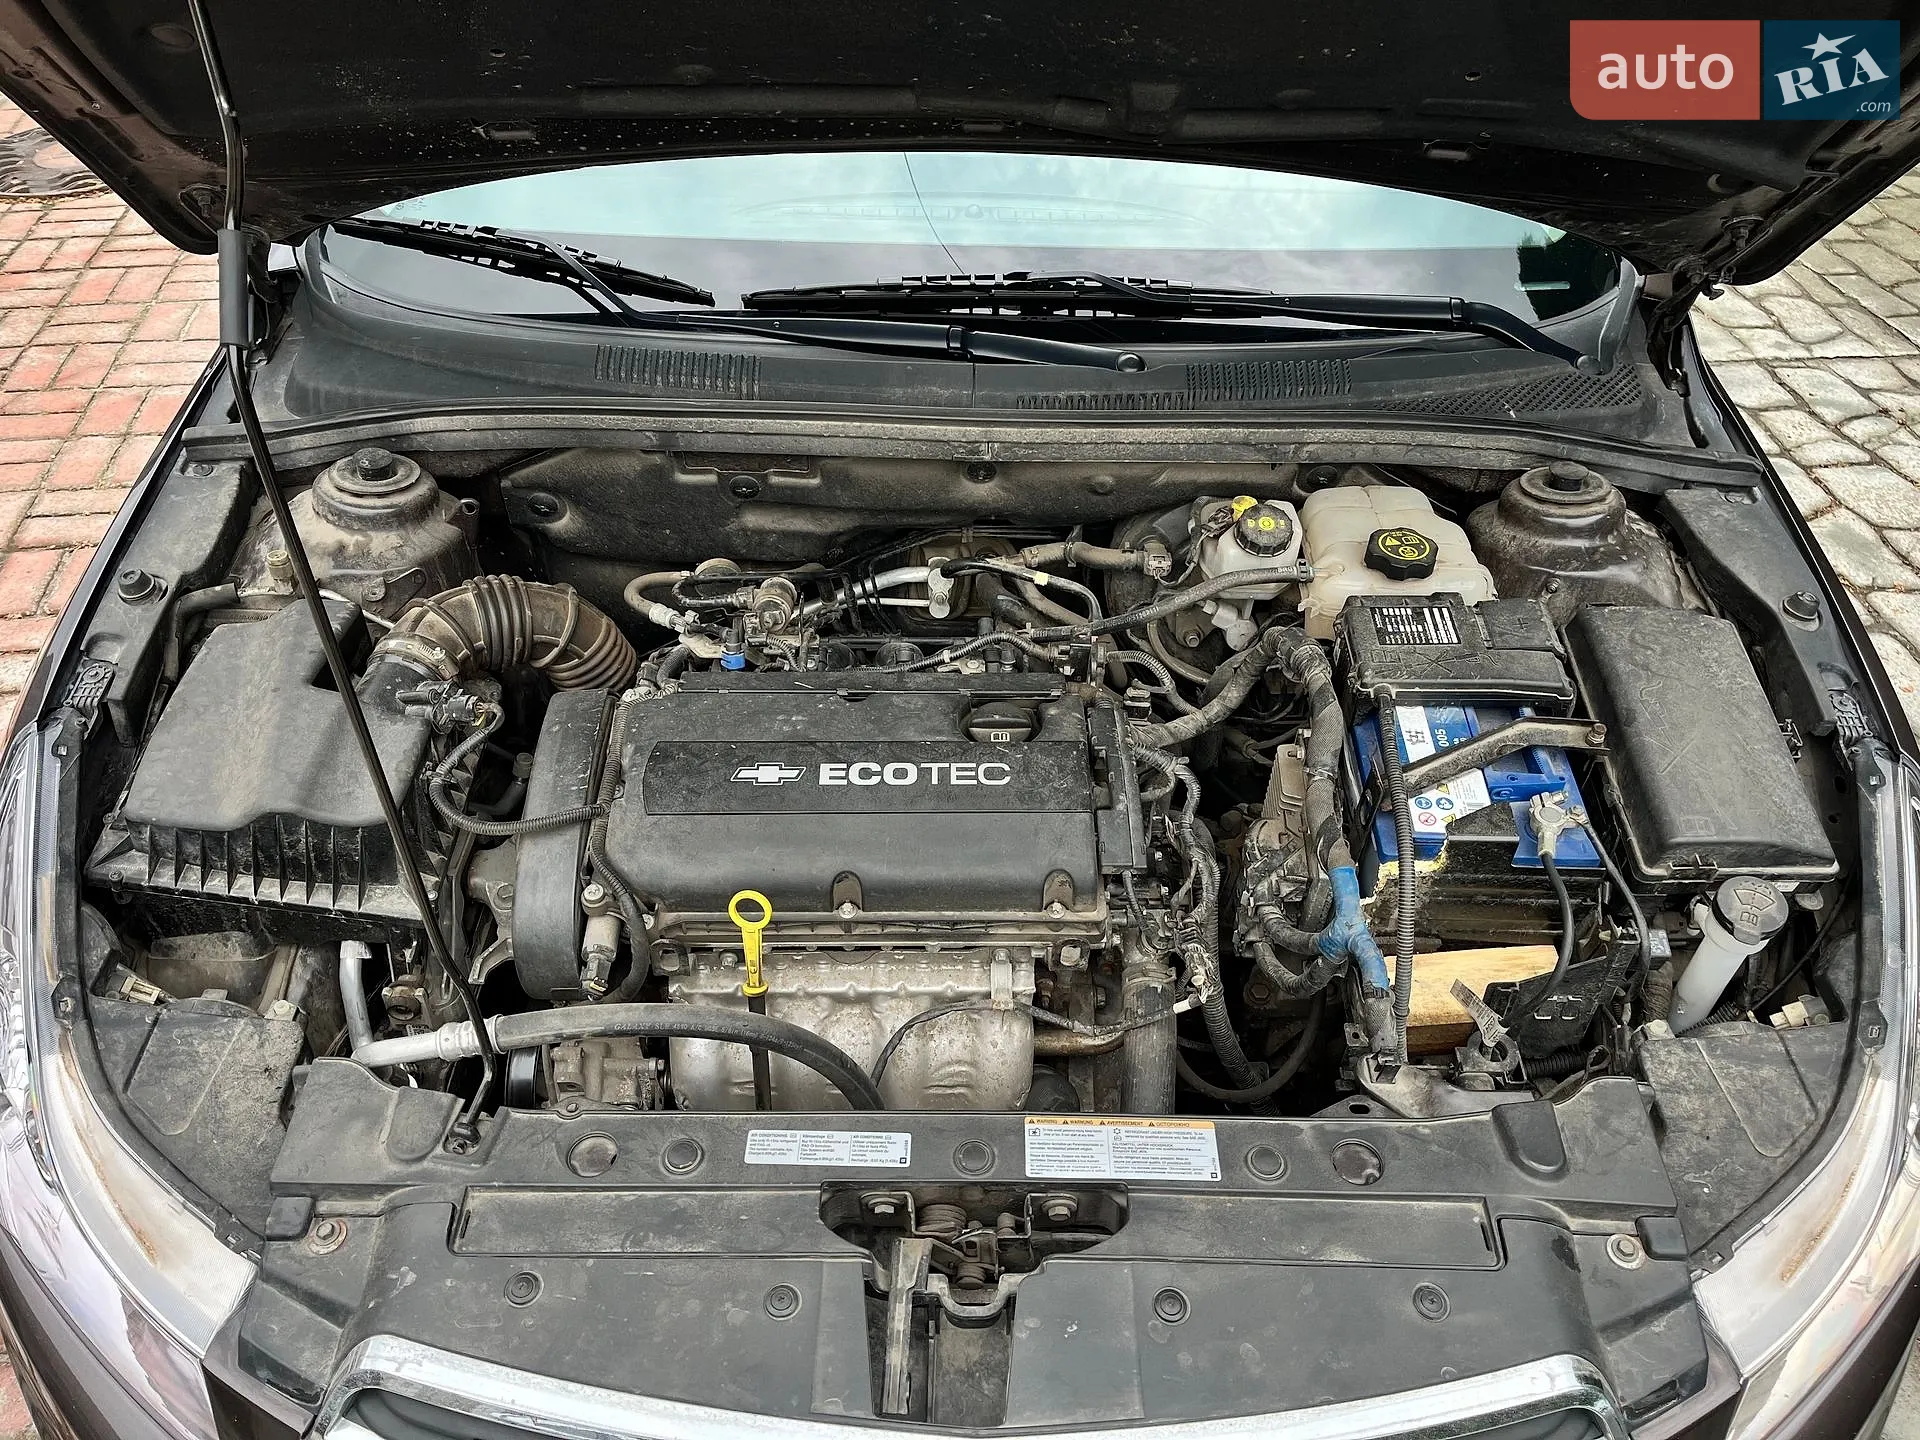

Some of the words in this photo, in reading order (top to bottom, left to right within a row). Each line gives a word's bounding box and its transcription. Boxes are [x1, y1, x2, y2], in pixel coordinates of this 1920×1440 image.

[1435, 728, 1450, 747] 005
[818, 762, 1011, 786] ECOTEC
[614, 1021, 652, 1031] GALAXY
